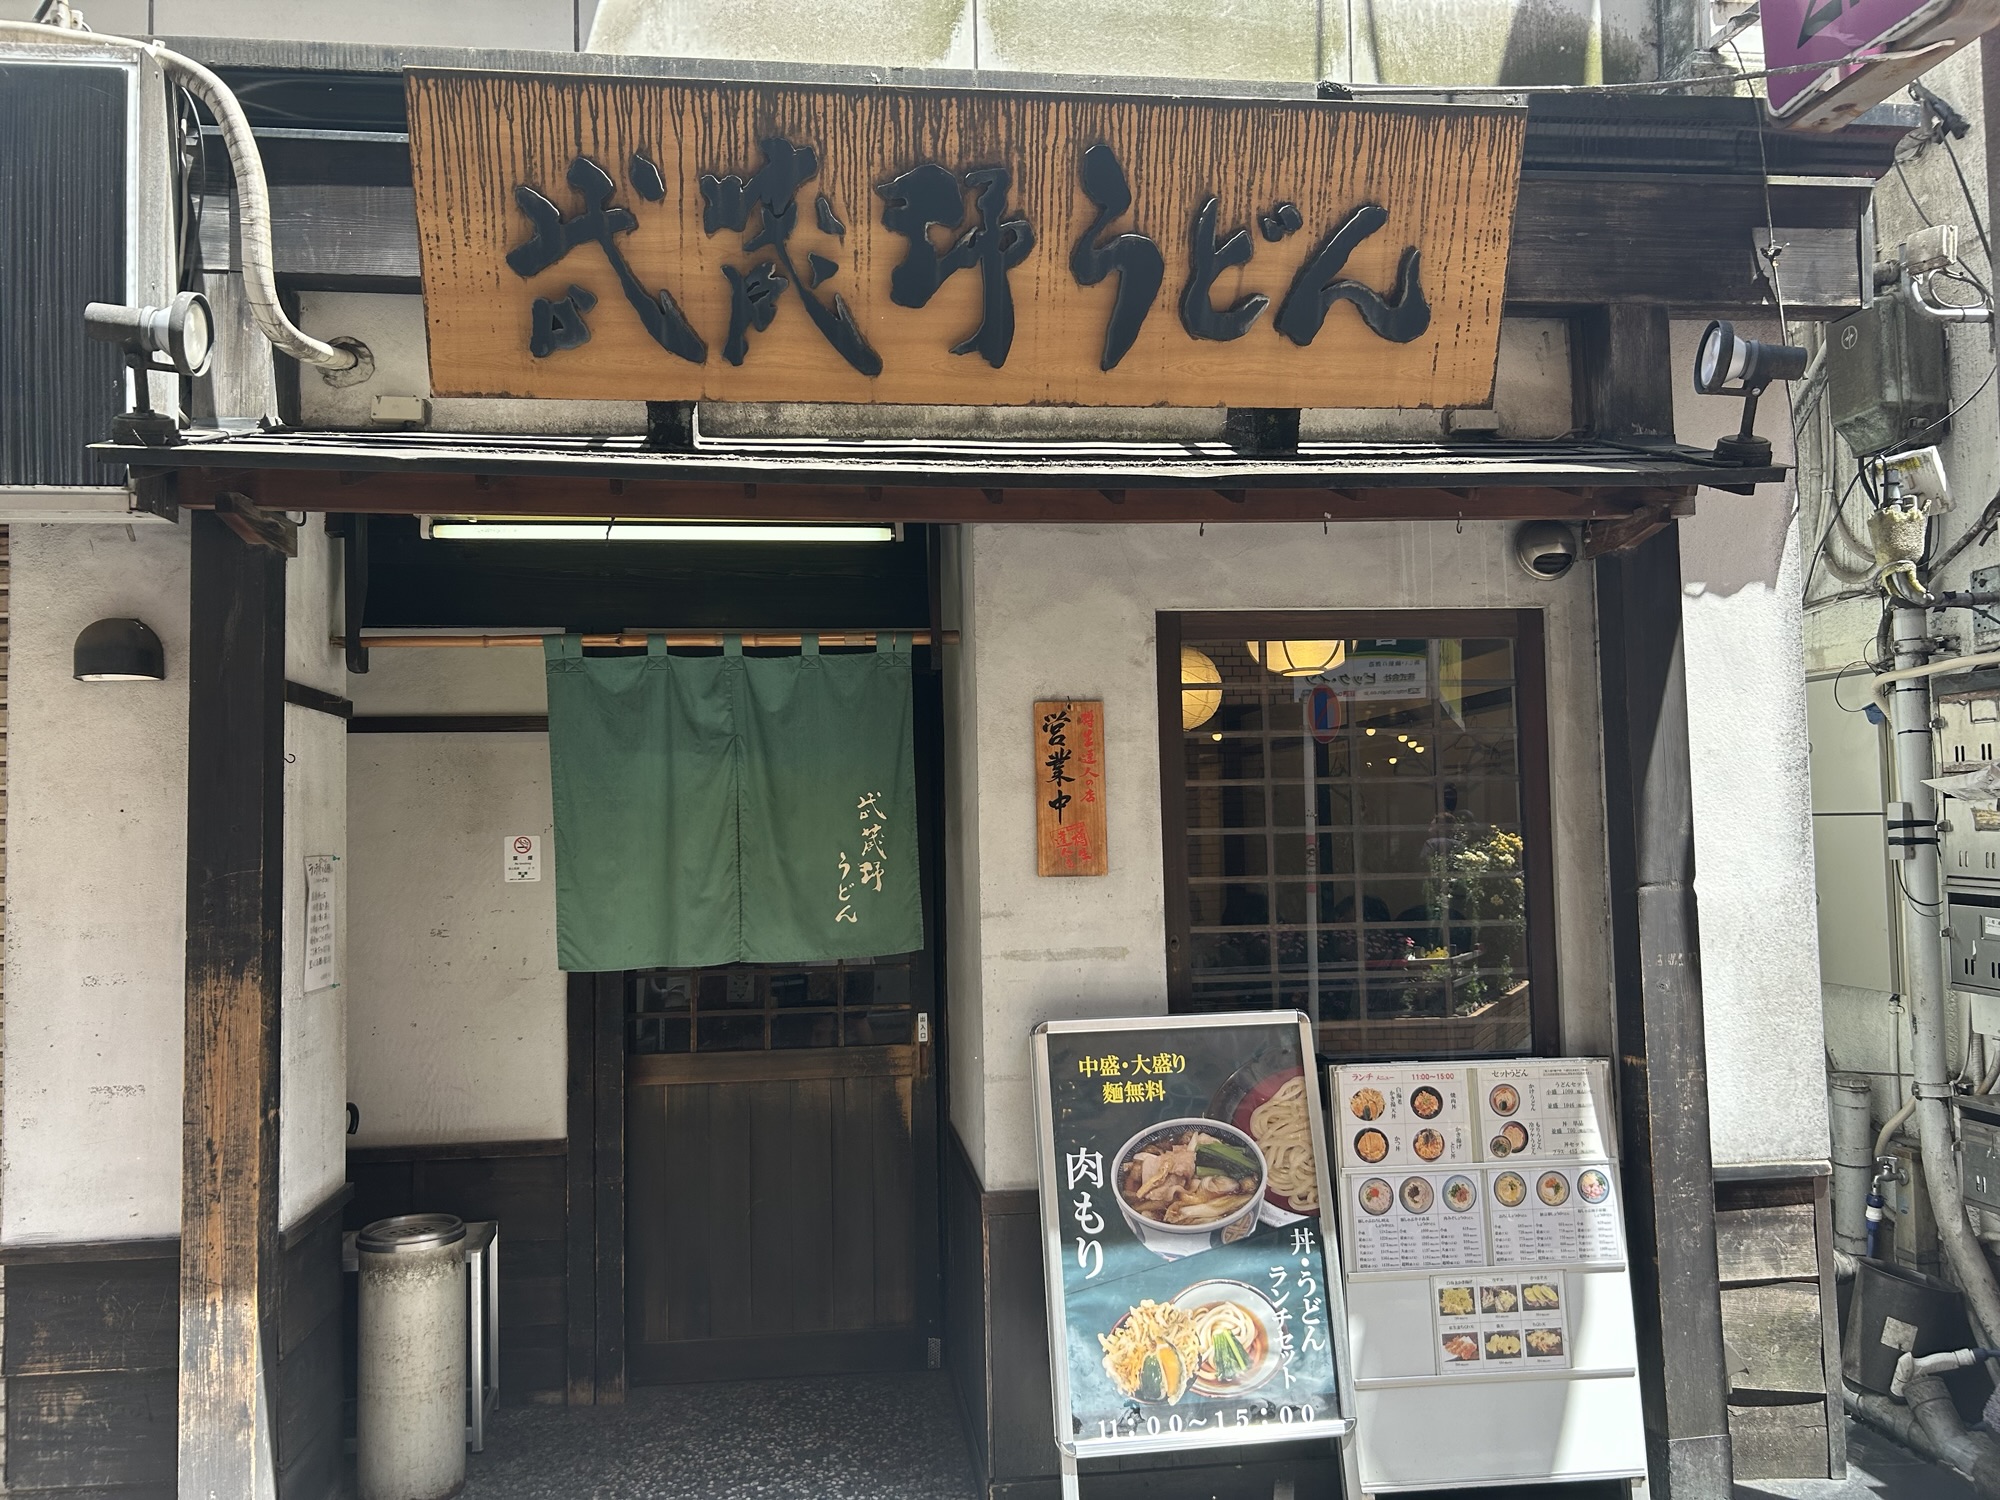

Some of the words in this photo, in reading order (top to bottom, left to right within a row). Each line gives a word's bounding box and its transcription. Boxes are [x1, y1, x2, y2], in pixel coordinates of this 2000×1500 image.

[506, 137, 1432, 377] 武蔵野うどん
[1042, 711, 1076, 825] 営業中
[835, 851, 858, 923] うどん
[857, 791, 888, 893] 武蔵野
[1352, 1072, 1374, 1081] ランチ
[1491, 1069, 1529, 1078] セットうどん
[1066, 1147, 1105, 1280] 肉もり
[1269, 1265, 1297, 1390] ランチセット
[1290, 1227, 1326, 1353] 丼・うどん
